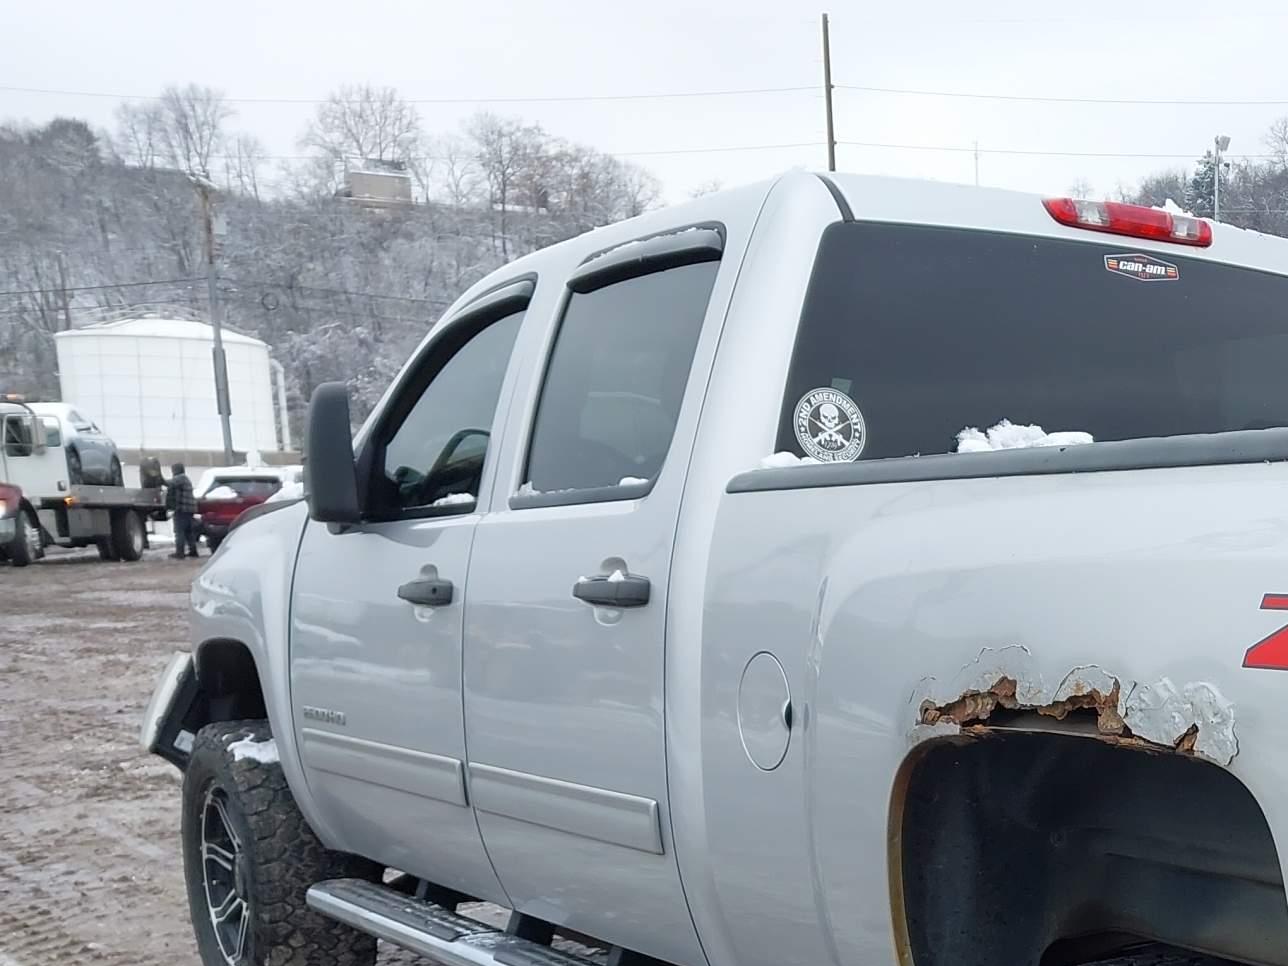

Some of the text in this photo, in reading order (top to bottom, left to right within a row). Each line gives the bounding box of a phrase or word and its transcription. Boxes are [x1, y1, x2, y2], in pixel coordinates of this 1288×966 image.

[1119, 260, 1167, 275] can-am
[798, 392, 861, 432] 2ND AMENDMENT
